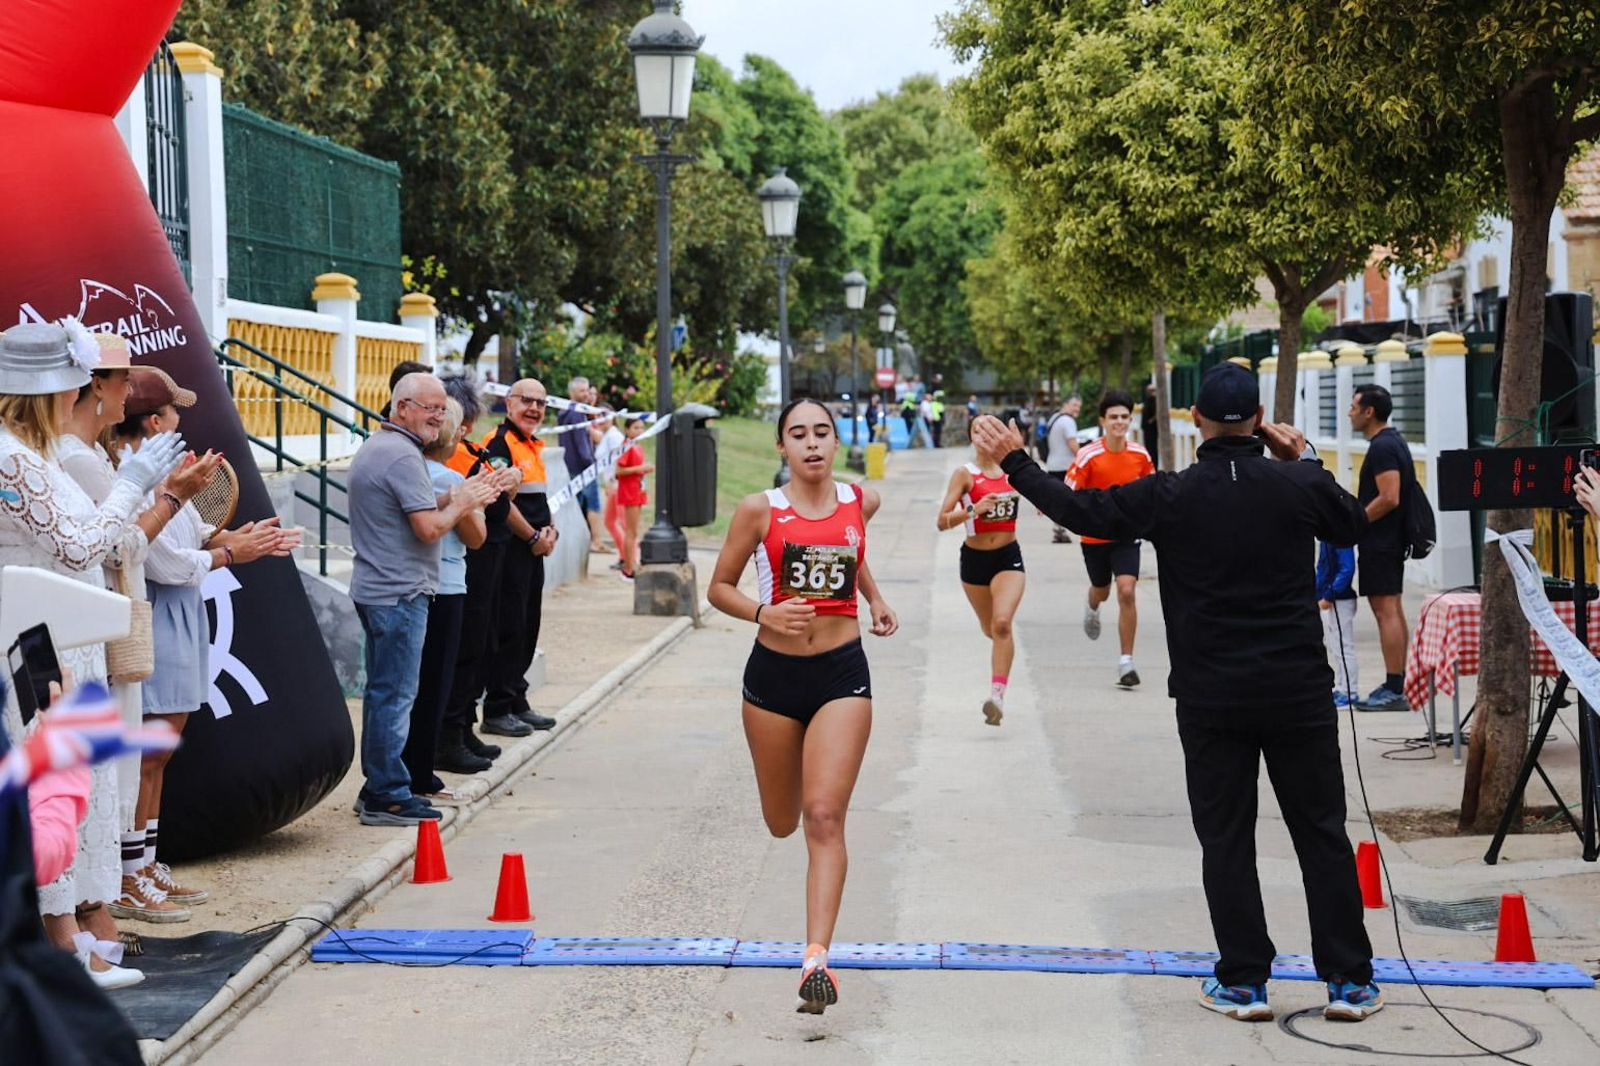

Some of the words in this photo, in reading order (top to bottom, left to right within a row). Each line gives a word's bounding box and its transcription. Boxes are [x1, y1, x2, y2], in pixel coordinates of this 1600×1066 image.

[125, 325, 187, 357] NNING
[986, 500, 1015, 518] 363
[789, 562, 846, 590] 365
